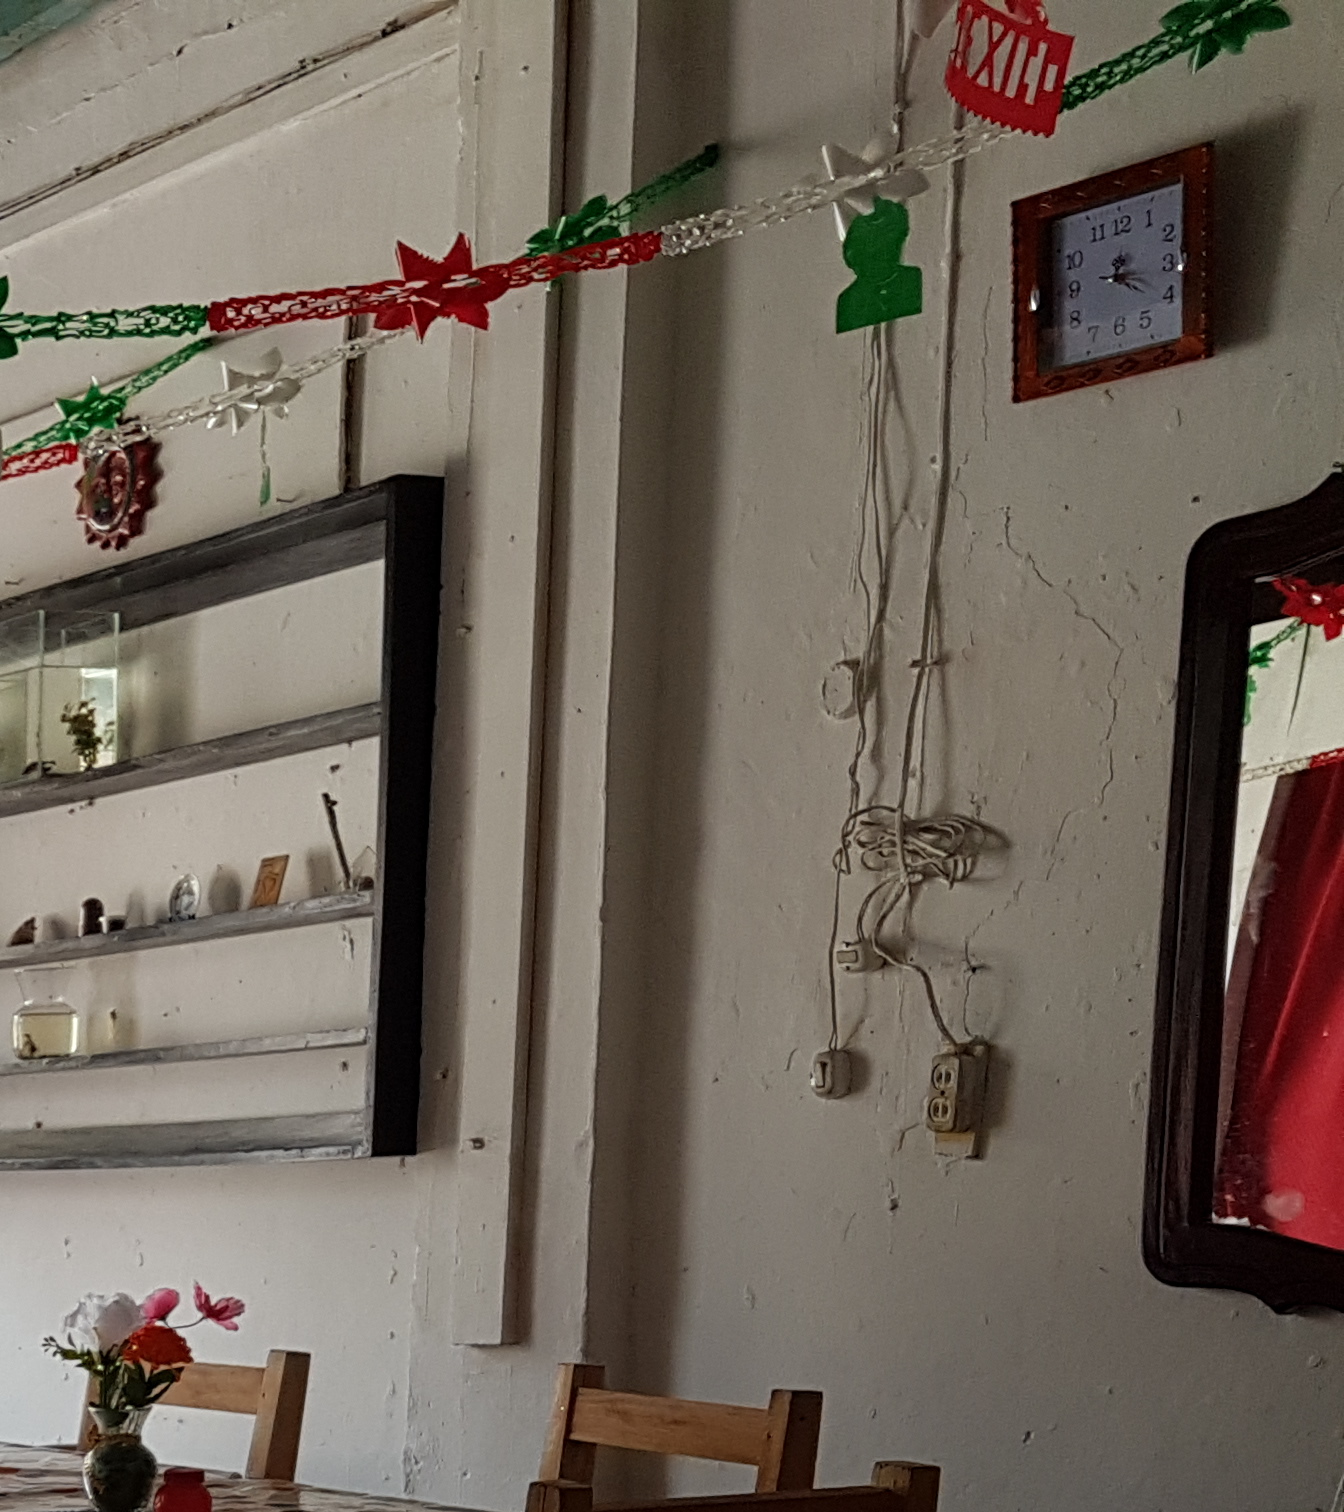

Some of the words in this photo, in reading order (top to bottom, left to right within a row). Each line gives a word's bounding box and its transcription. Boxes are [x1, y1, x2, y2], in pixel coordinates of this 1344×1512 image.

[1113, 215, 1132, 236] 12
[1145, 209, 1154, 228] 1
[1090, 223, 1106, 243] 11
[1162, 223, 1176, 242] 2
[1066, 250, 1084, 271] 10
[1162, 252, 1174, 273] 3
[1068, 280, 1081, 299] 9
[1162, 284, 1175, 304] 4
[1070, 310, 1082, 329] 8
[1114, 315, 1126, 336] 6
[1139, 310, 1151, 329] 5
[1088, 325, 1100, 342] 7
